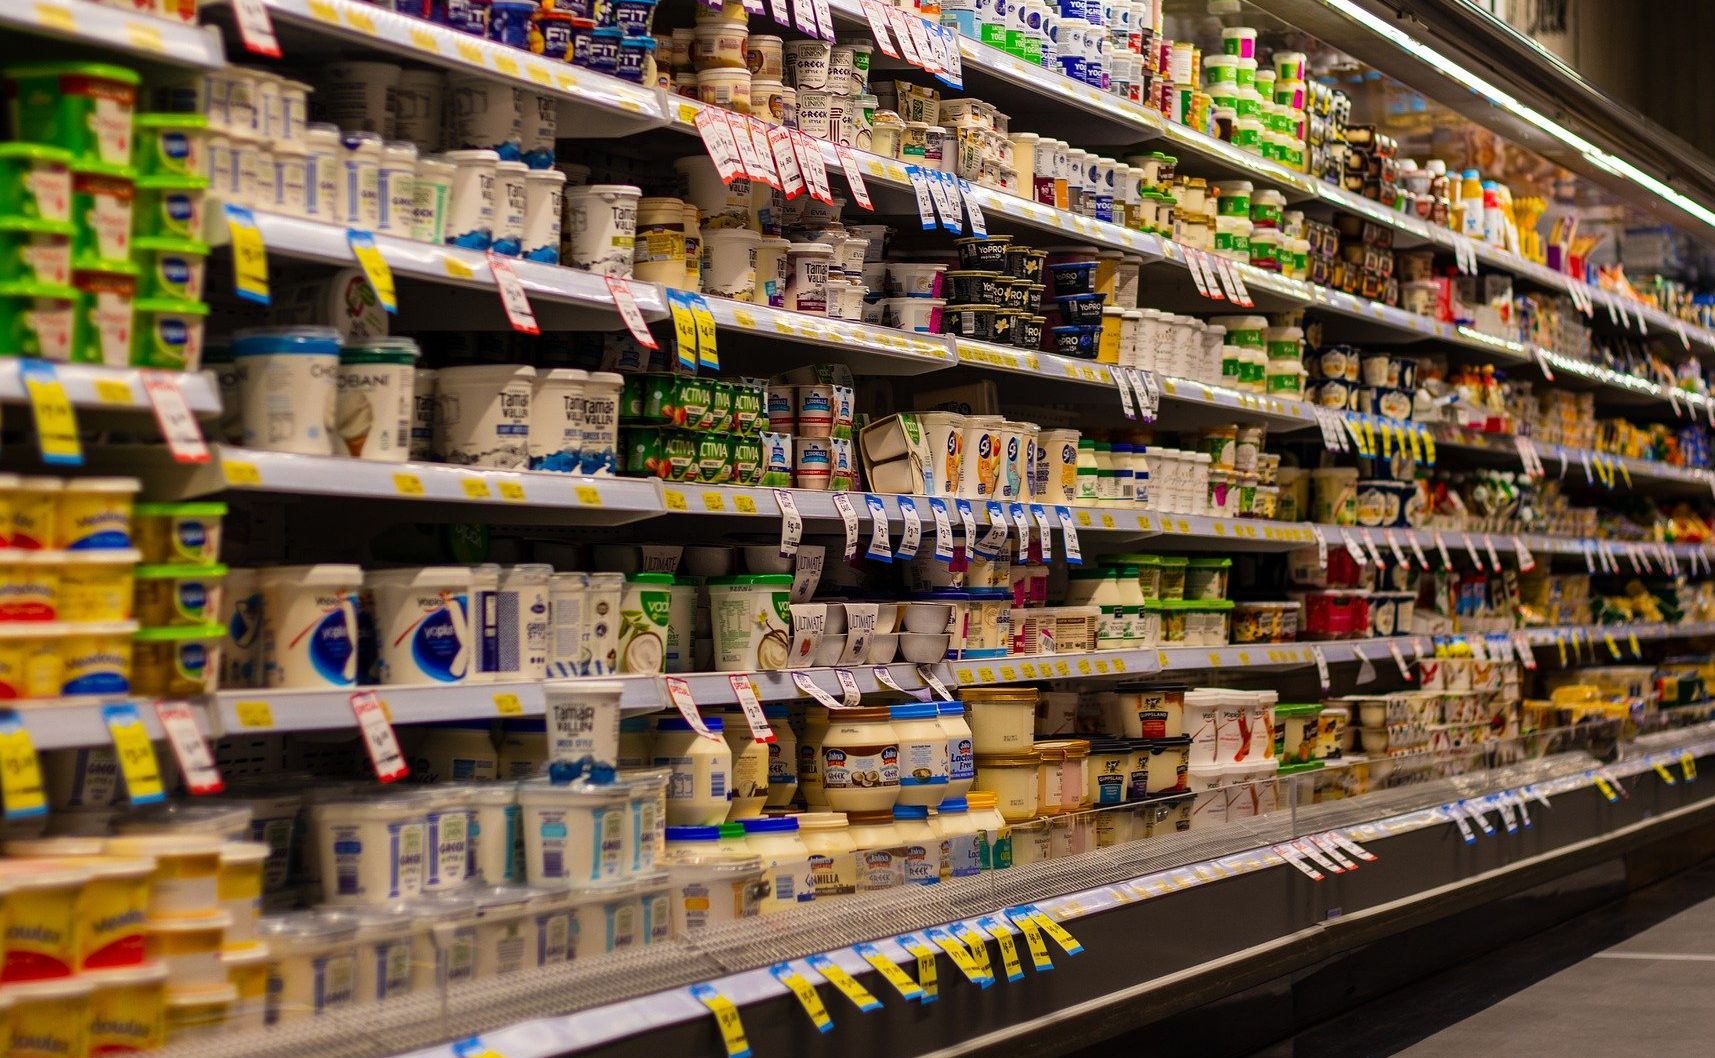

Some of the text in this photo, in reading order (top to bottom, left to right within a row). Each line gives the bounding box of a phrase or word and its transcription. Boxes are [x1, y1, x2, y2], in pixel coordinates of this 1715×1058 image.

[680, 388, 710, 405] ACTIVIA
[735, 396, 760, 411] ACTIVIA
[666, 440, 696, 456] ACTIVIA
[735, 446, 760, 460] ACTIVIA
[795, 614, 824, 632] ULTIMATE
[849, 614, 875, 631] ULTIMATE
[554, 705, 594, 720] Tamar
